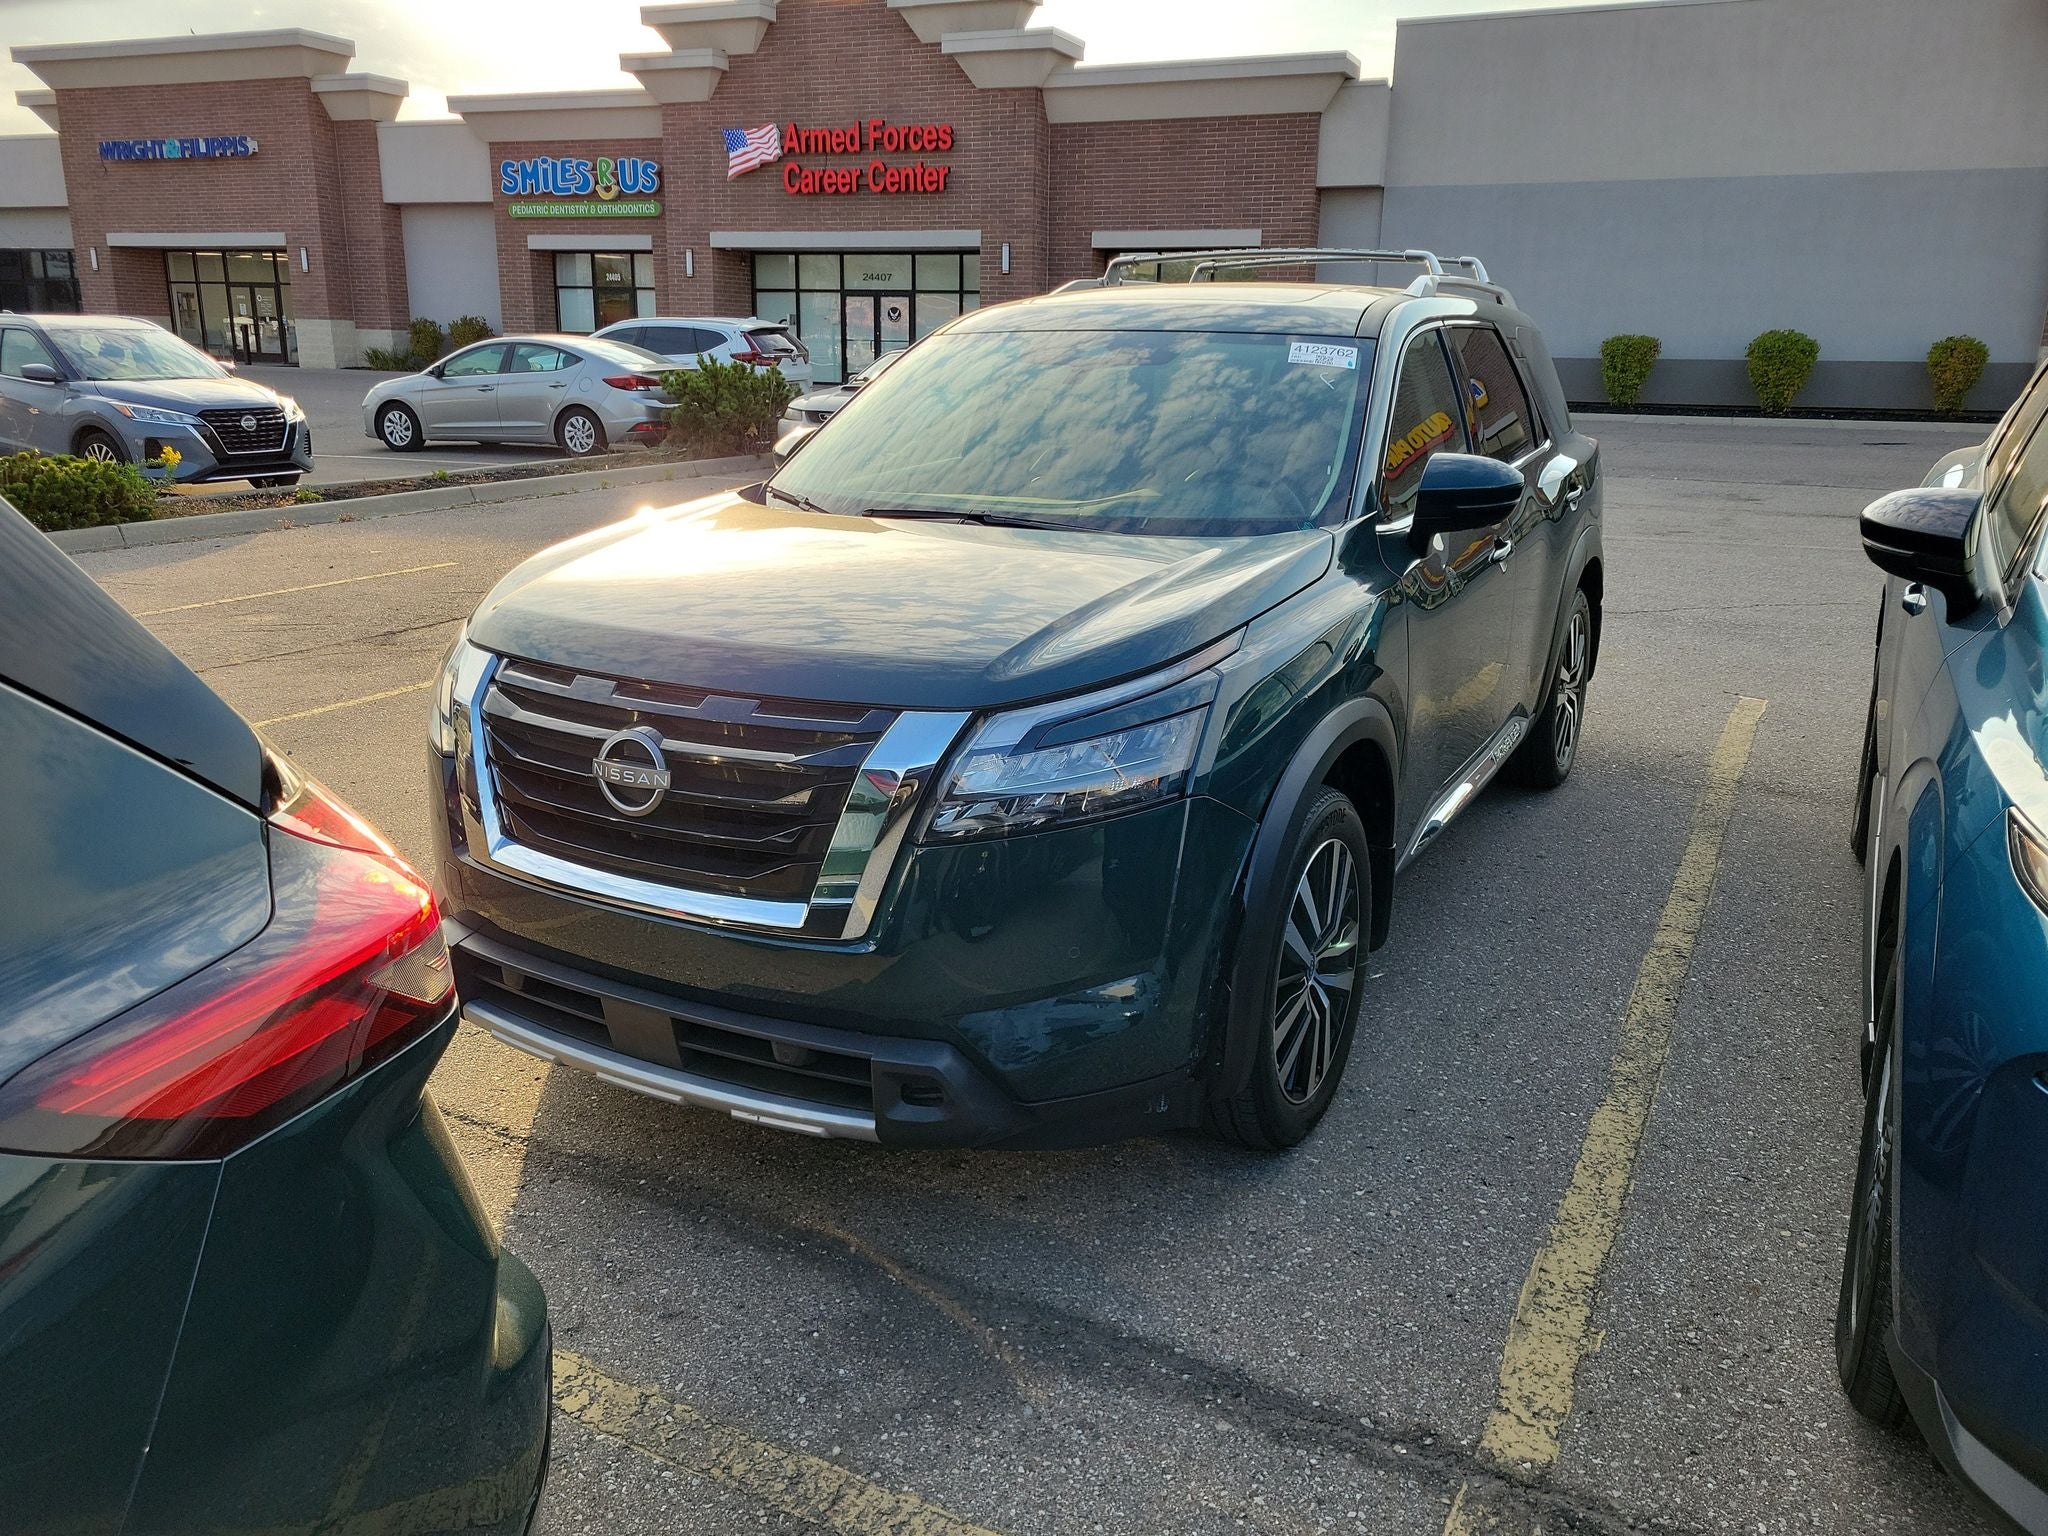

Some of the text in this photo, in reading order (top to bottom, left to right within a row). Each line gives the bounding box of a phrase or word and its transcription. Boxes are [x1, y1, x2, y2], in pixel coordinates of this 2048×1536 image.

[782, 117, 954, 155] Armed Forces
[597, 157, 615, 186] R
[617, 157, 660, 194] US
[783, 160, 950, 194] Career Center
[512, 205, 549, 214] PEDIATRIC
[550, 205, 589, 214] DENTISTRY
[597, 204, 655, 214] ORTHODONTICS
[862, 273, 893, 281] 24407
[1294, 345, 1354, 358] 4123762
[594, 762, 668, 787] NISSAN
